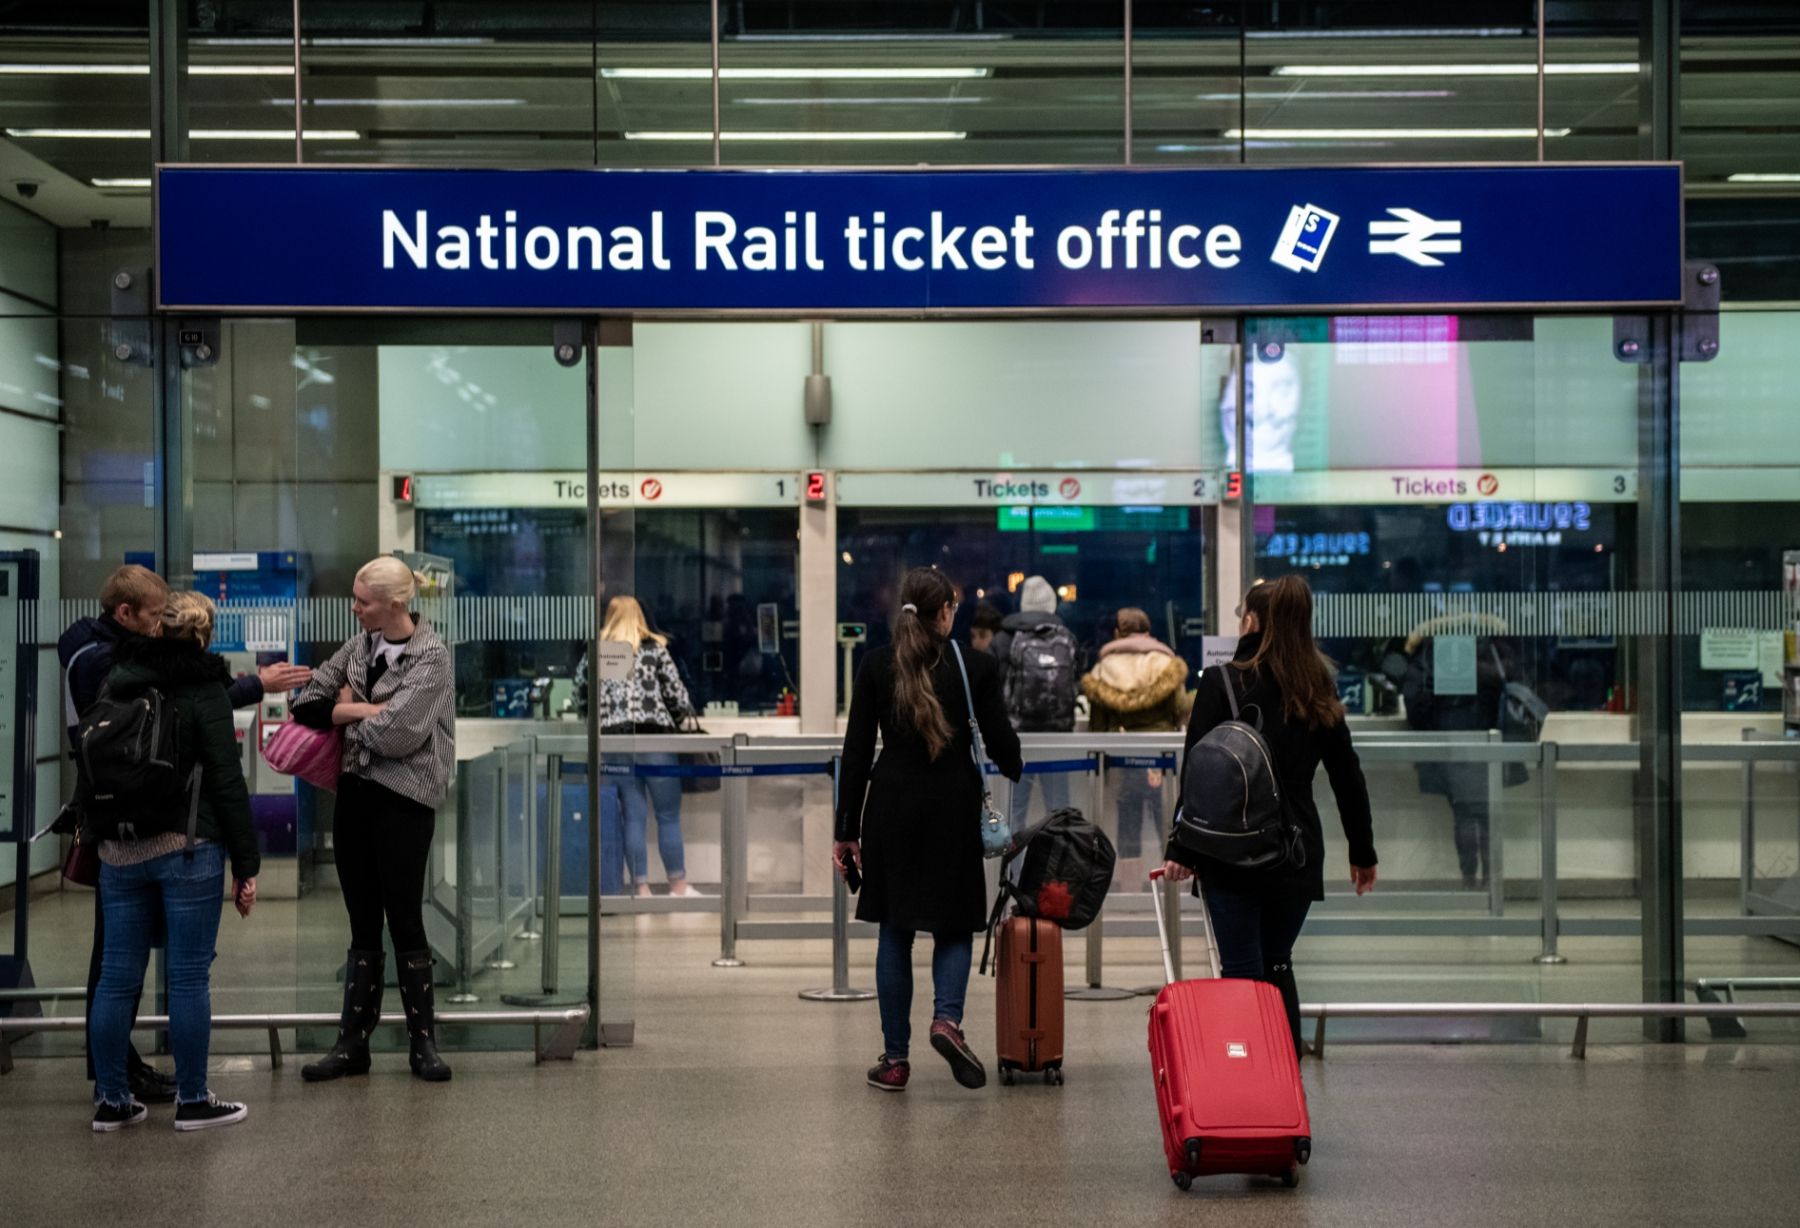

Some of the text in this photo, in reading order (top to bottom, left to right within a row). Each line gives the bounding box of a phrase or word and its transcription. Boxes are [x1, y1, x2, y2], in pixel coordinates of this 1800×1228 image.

[382, 208, 1242, 271] National Rail ticket office
[553, 480, 630, 498] Ticets
[776, 479, 786, 496] 1
[973, 479, 1049, 497] Tickets
[1193, 479, 1205, 497] 2
[1227, 472, 1242, 498] 3
[1391, 477, 1467, 495] Tickets
[1613, 477, 1626, 494] 3
